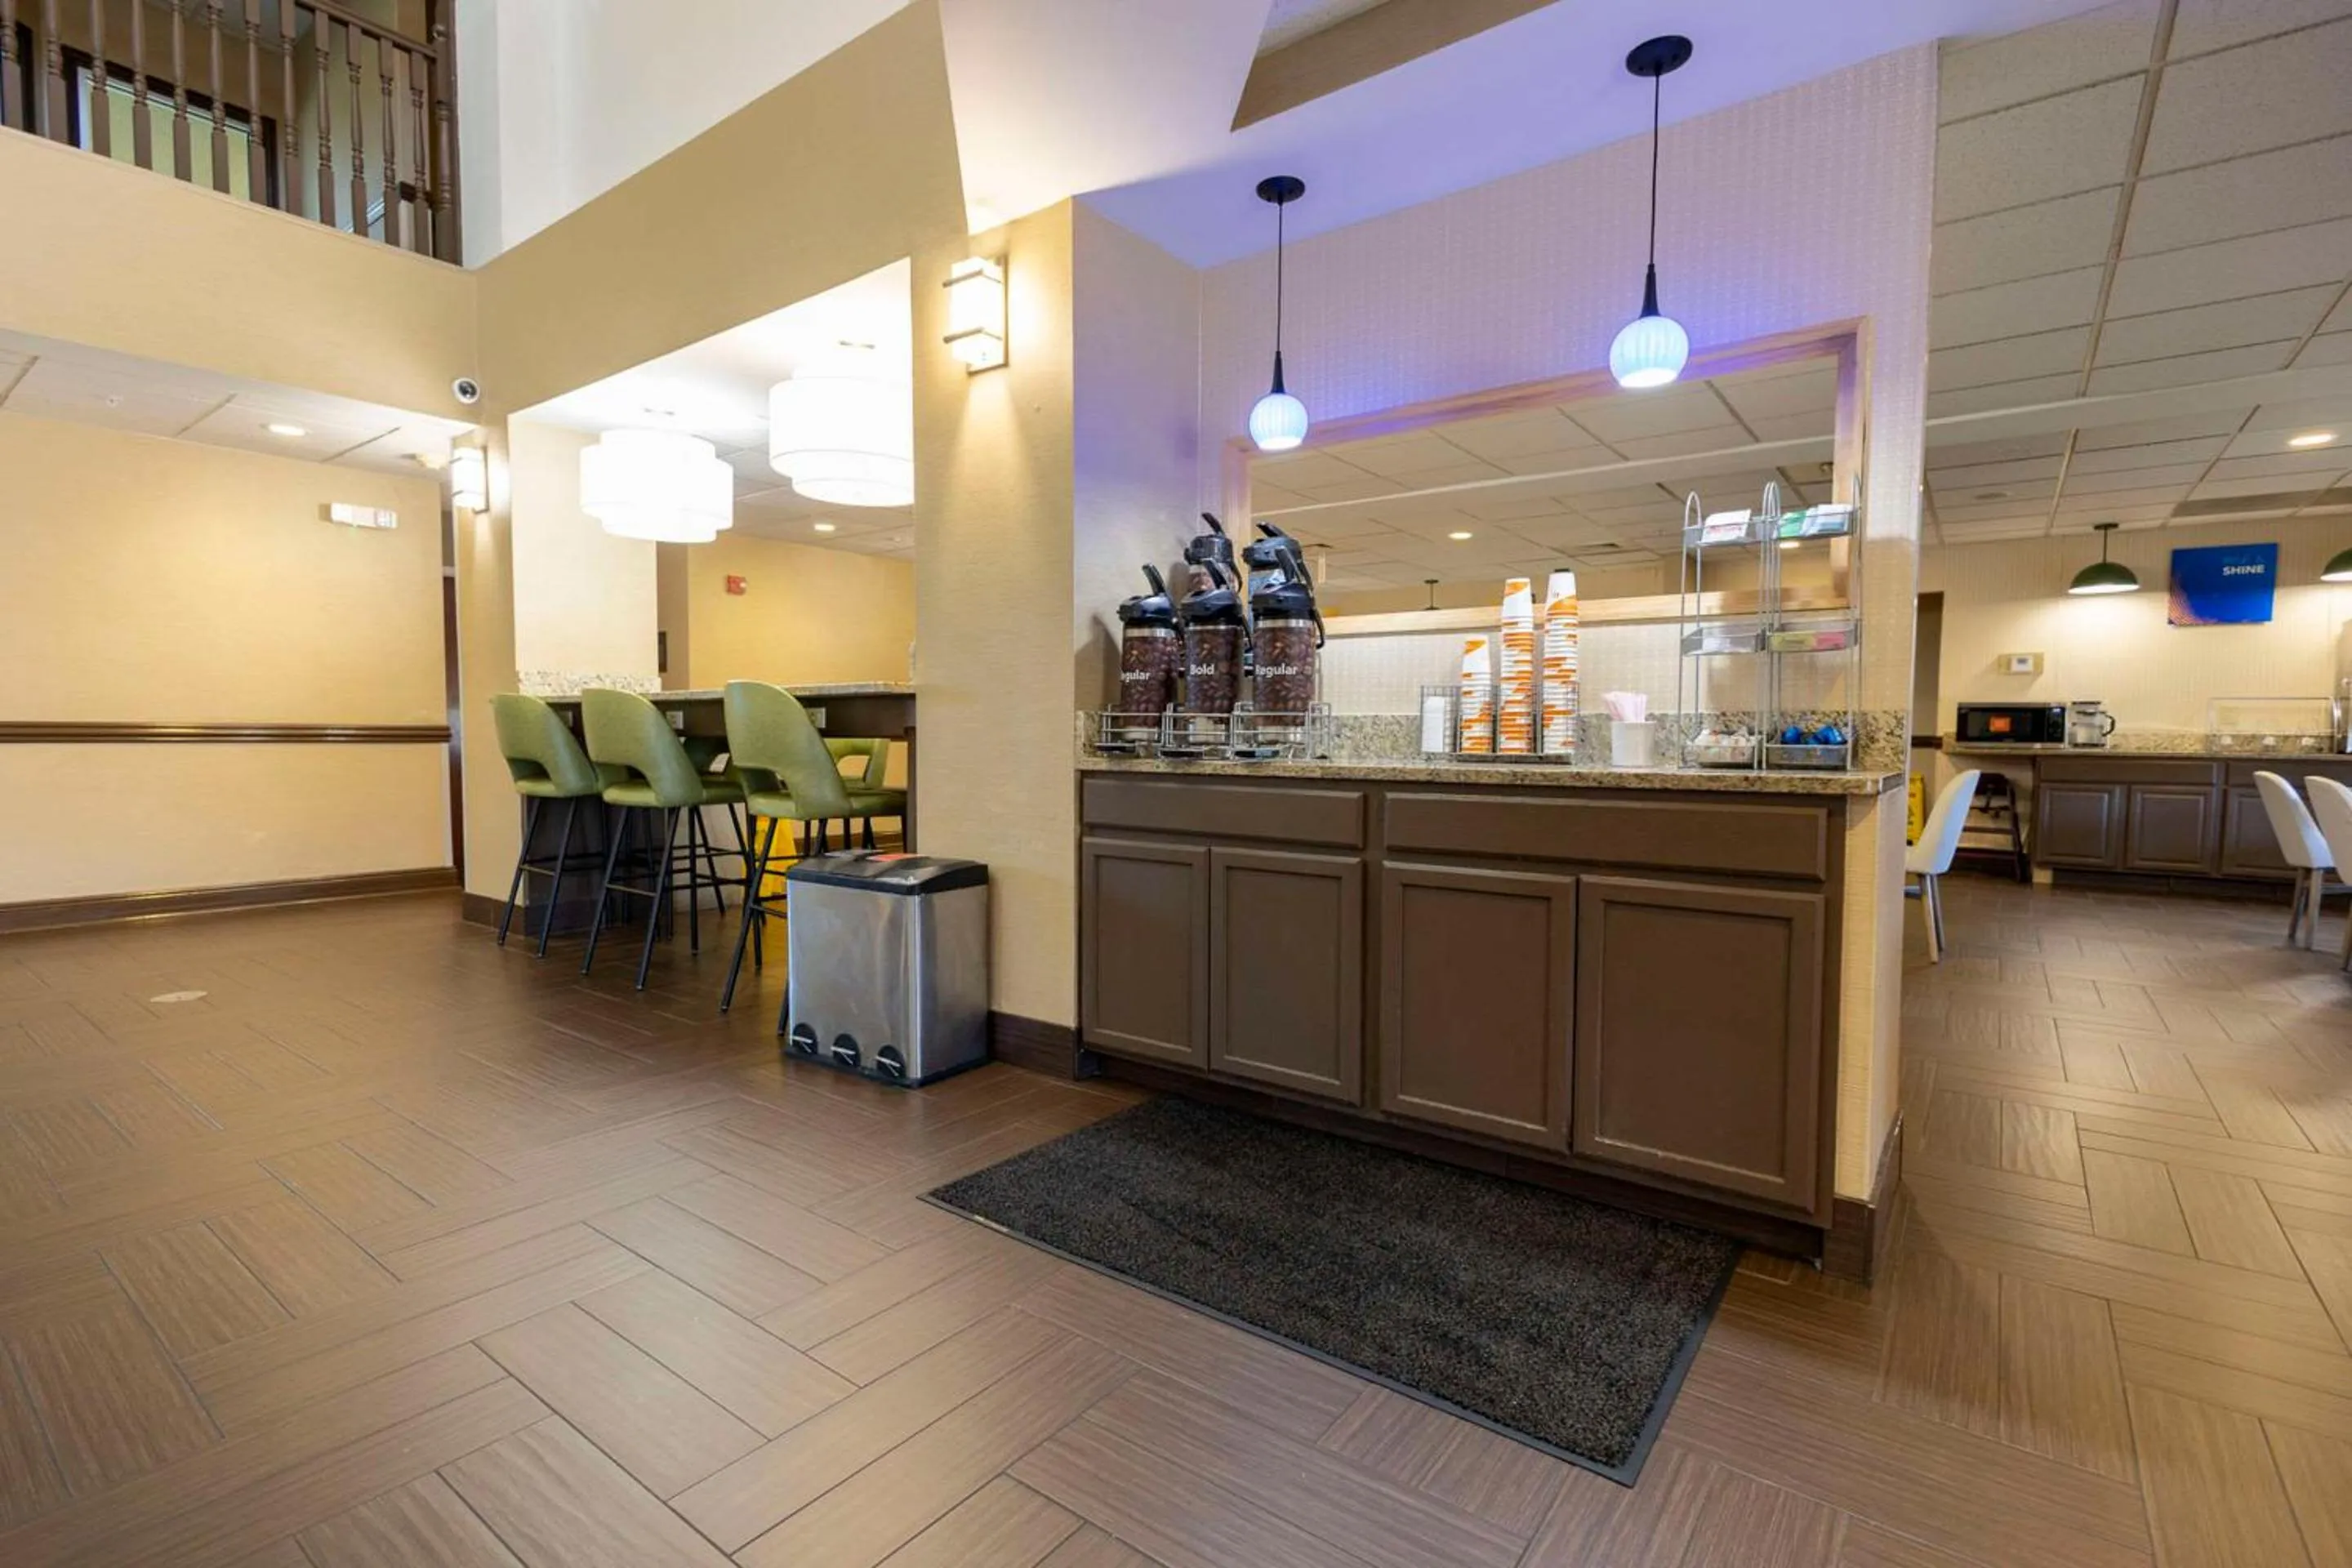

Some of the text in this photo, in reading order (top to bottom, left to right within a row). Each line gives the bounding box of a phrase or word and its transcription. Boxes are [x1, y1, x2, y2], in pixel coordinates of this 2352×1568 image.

[2222, 564, 2265, 576] SHINE
[1190, 663, 1214, 675] Bold
[1255, 662, 1298, 678] Regular
